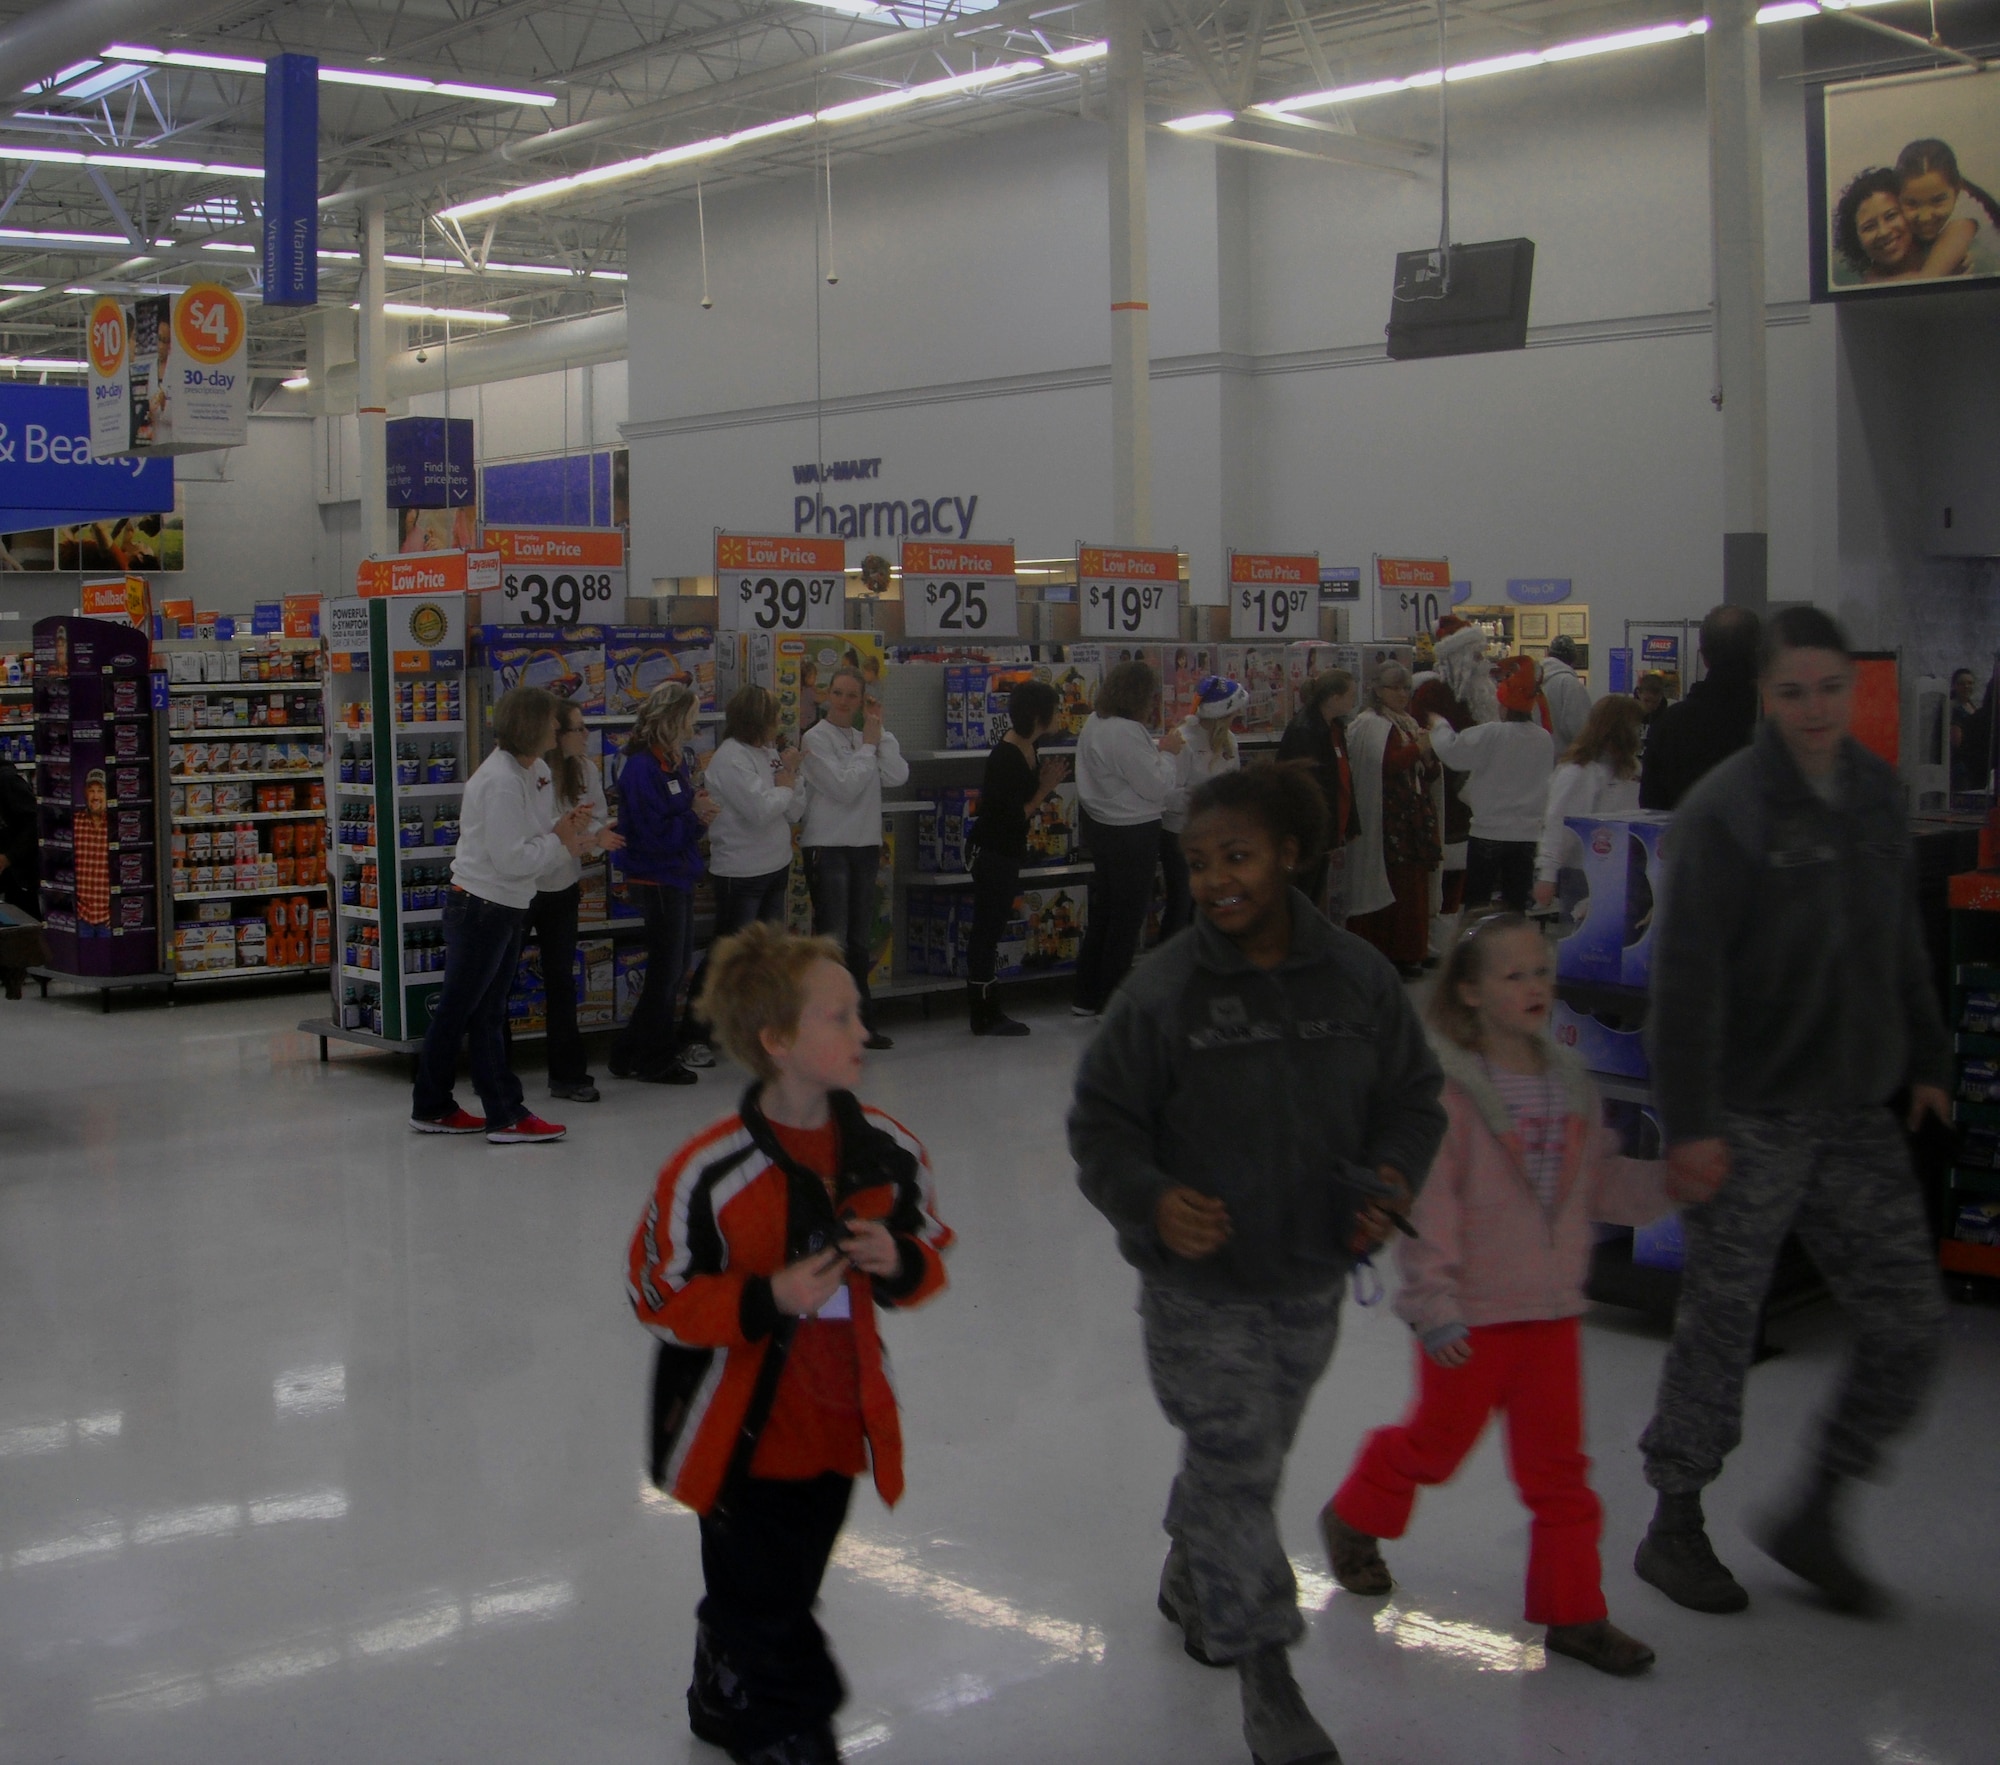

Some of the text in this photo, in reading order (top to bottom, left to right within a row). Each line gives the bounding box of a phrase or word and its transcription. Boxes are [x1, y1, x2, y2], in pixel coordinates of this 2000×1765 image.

[267, 219, 278, 292] Vitamins
[293, 218, 308, 291] Vitamins
[190, 300, 229, 344] $4
[94, 320, 121, 358] $10
[184, 370, 235, 391] 30-day
[96, 382, 122, 400] 90-day
[424, 462, 443, 472] Find
[424, 476, 446, 486] price
[795, 493, 978, 540] Pharmacy
[514, 541, 582, 557] Low Price
[747, 549, 817, 565] Low Price
[468, 560, 498, 573] Layaway
[929, 554, 993, 571] Low Price
[1103, 558, 1157, 575] Low Price
[392, 569, 446, 591] Low Price
[1251, 565, 1301, 580] Low Price
[1395, 568, 1435, 582] Low Price
[333, 608, 368, 619] POWERFUL
[927, 582, 988, 630] $25
[1649, 641, 1671, 650] HALLS
[154, 676, 164, 690] H
[155, 695, 163, 707] 2
[992, 714, 1008, 730] BIG
